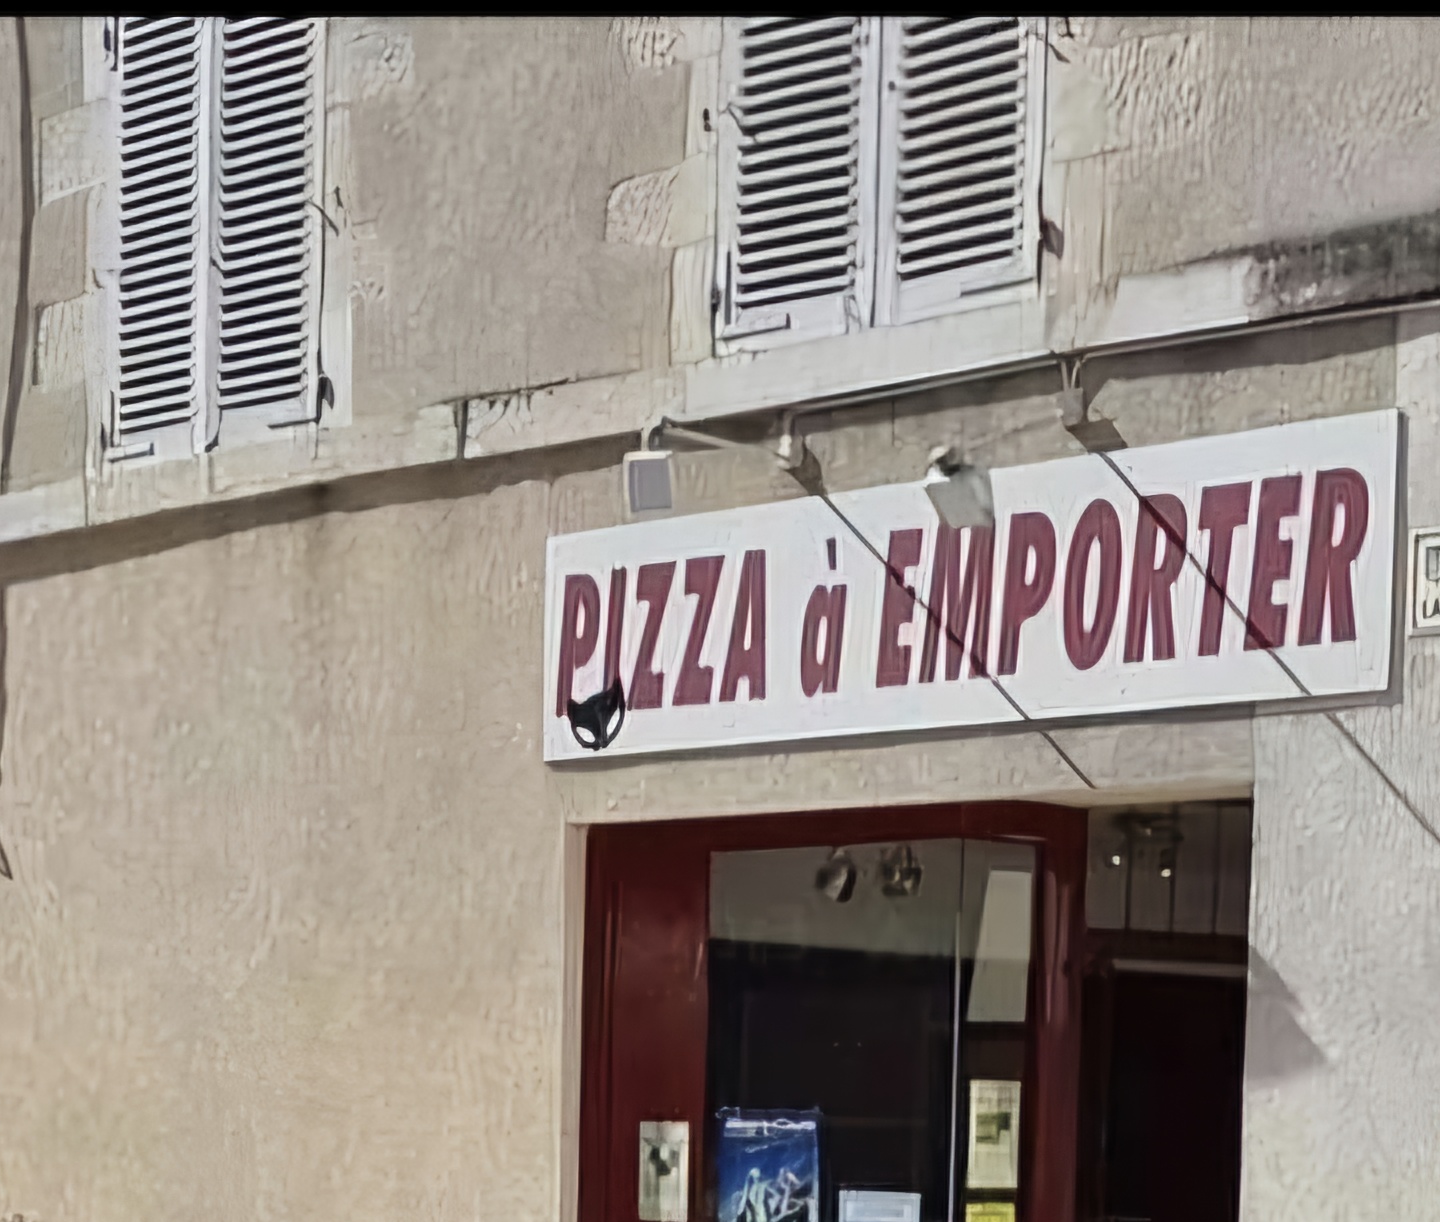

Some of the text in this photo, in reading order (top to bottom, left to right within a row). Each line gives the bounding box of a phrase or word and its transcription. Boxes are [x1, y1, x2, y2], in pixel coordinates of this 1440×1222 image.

[555, 469, 1369, 716] PIZZA à EMPORTER
